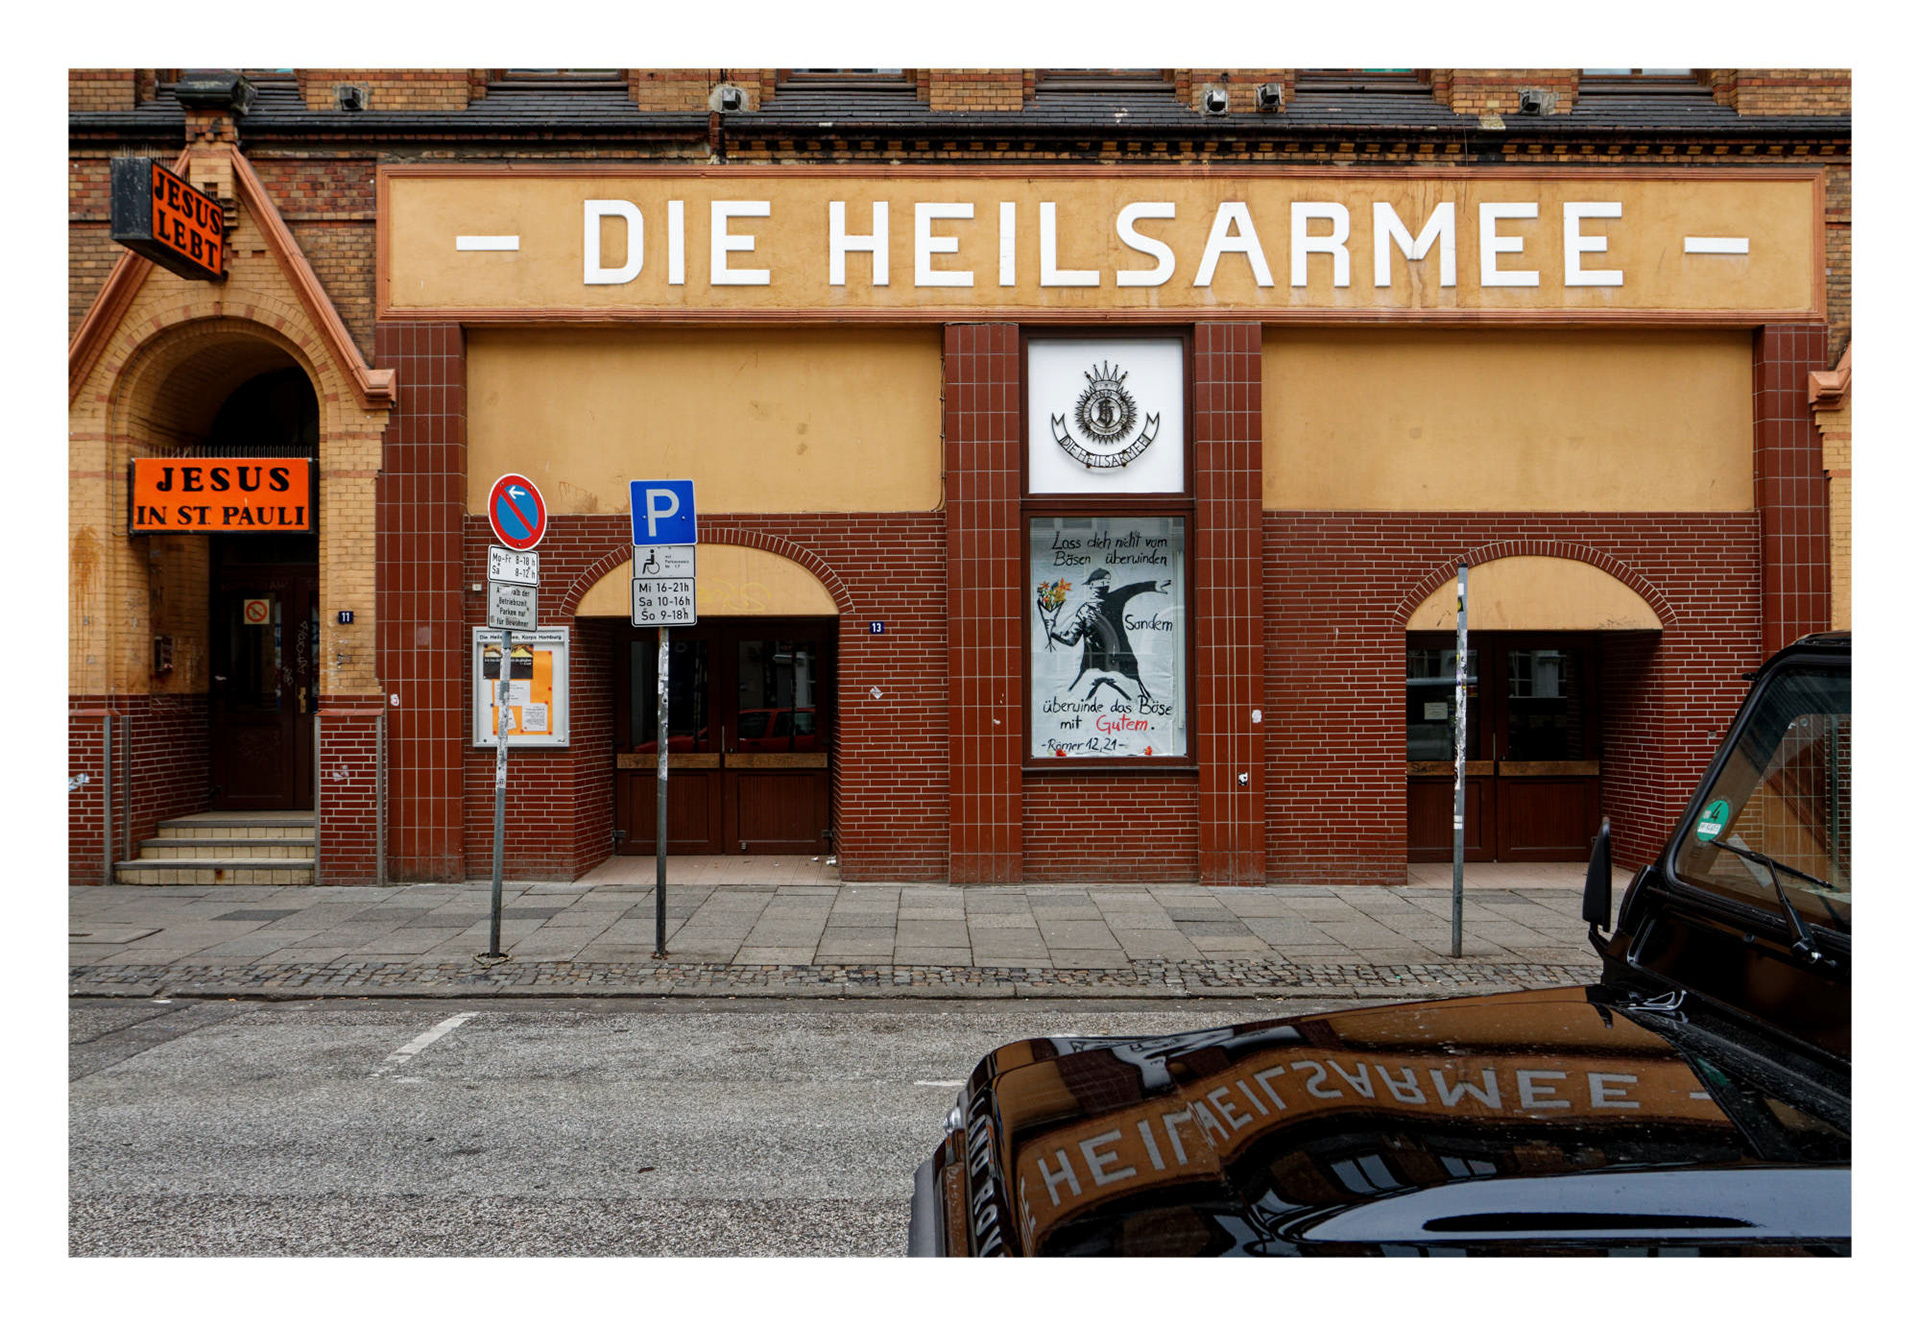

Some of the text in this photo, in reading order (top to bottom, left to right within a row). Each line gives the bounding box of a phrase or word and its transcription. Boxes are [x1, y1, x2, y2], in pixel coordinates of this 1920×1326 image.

[155, 171, 220, 236] JESUS
[158, 208, 218, 268] LEBT
[583, 199, 771, 286] DIE
[828, 200, 1624, 288] HEILSARMEE
[1060, 435, 1149, 468] DIE HEILSARMEE
[156, 466, 290, 492] JESUS
[136, 505, 167, 525] IN
[222, 505, 305, 526] PAULI
[646, 488, 680, 537] P
[1051, 530, 1168, 550] Lass dich nicht vom
[492, 552, 536, 566] Mo-Fr 8-18 h
[1053, 548, 1168, 567] Bösen überwinden
[492, 564, 536, 579] Sa 8-12 h
[639, 582, 690, 593] Mi 16-21h
[498, 596, 527, 607] Betriebszeit
[638, 595, 691, 607] Sa 10-16h
[341, 612, 350, 622] 11
[500, 607, 517, 616] Parken
[641, 609, 689, 621] So 9-18h
[505, 617, 529, 627] Bewohner
[871, 622, 882, 633] 13
[1042, 694, 1173, 716] überwinde das Böse
[1060, 715, 1082, 730] mit
[1710, 802, 1722, 821] 4
[968, 1096, 1004, 1257] LAND ROV
